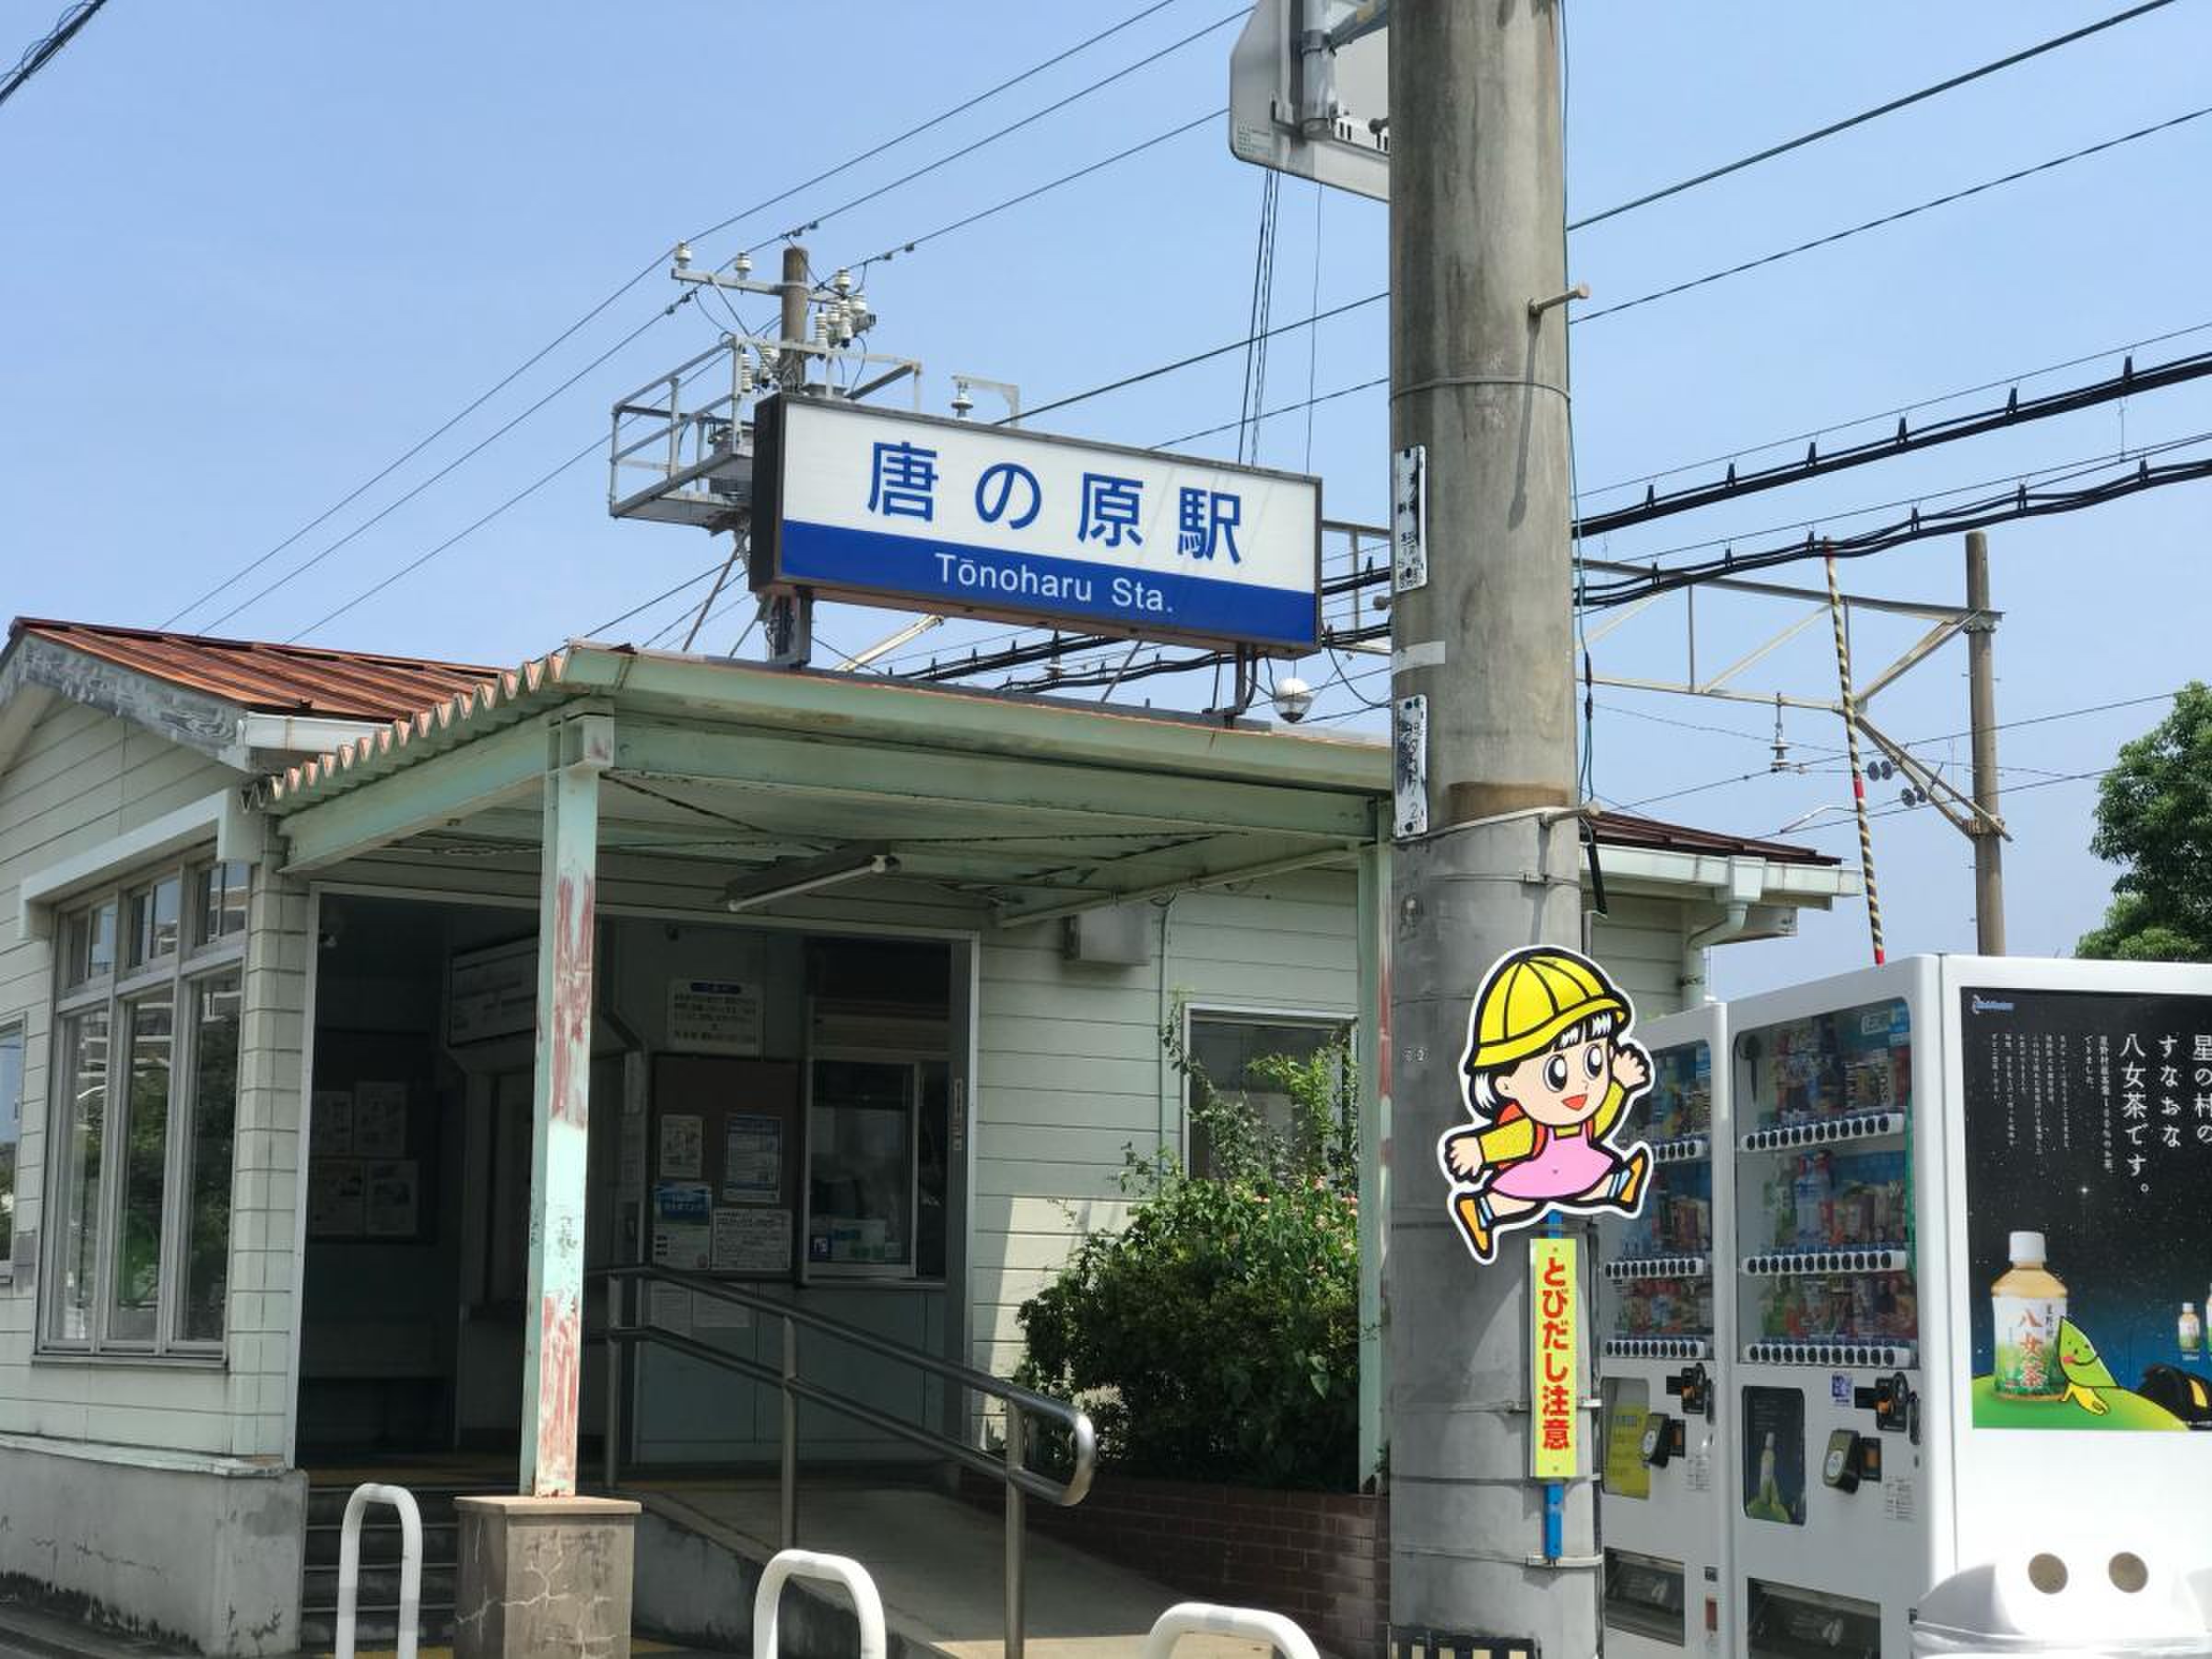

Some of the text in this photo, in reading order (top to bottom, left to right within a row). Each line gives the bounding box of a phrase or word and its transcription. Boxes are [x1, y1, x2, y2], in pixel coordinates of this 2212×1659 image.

[866, 441, 1242, 565] 唐の原駅
[934, 552, 1173, 613] Tōnoharu Sta.
[2119, 1032, 2149, 1193] 八女茶です。
[2158, 1034, 2183, 1147] すなおな
[2193, 1033, 2212, 1143] 星の村の
[1542, 1256, 1570, 1451] とびだし注意
